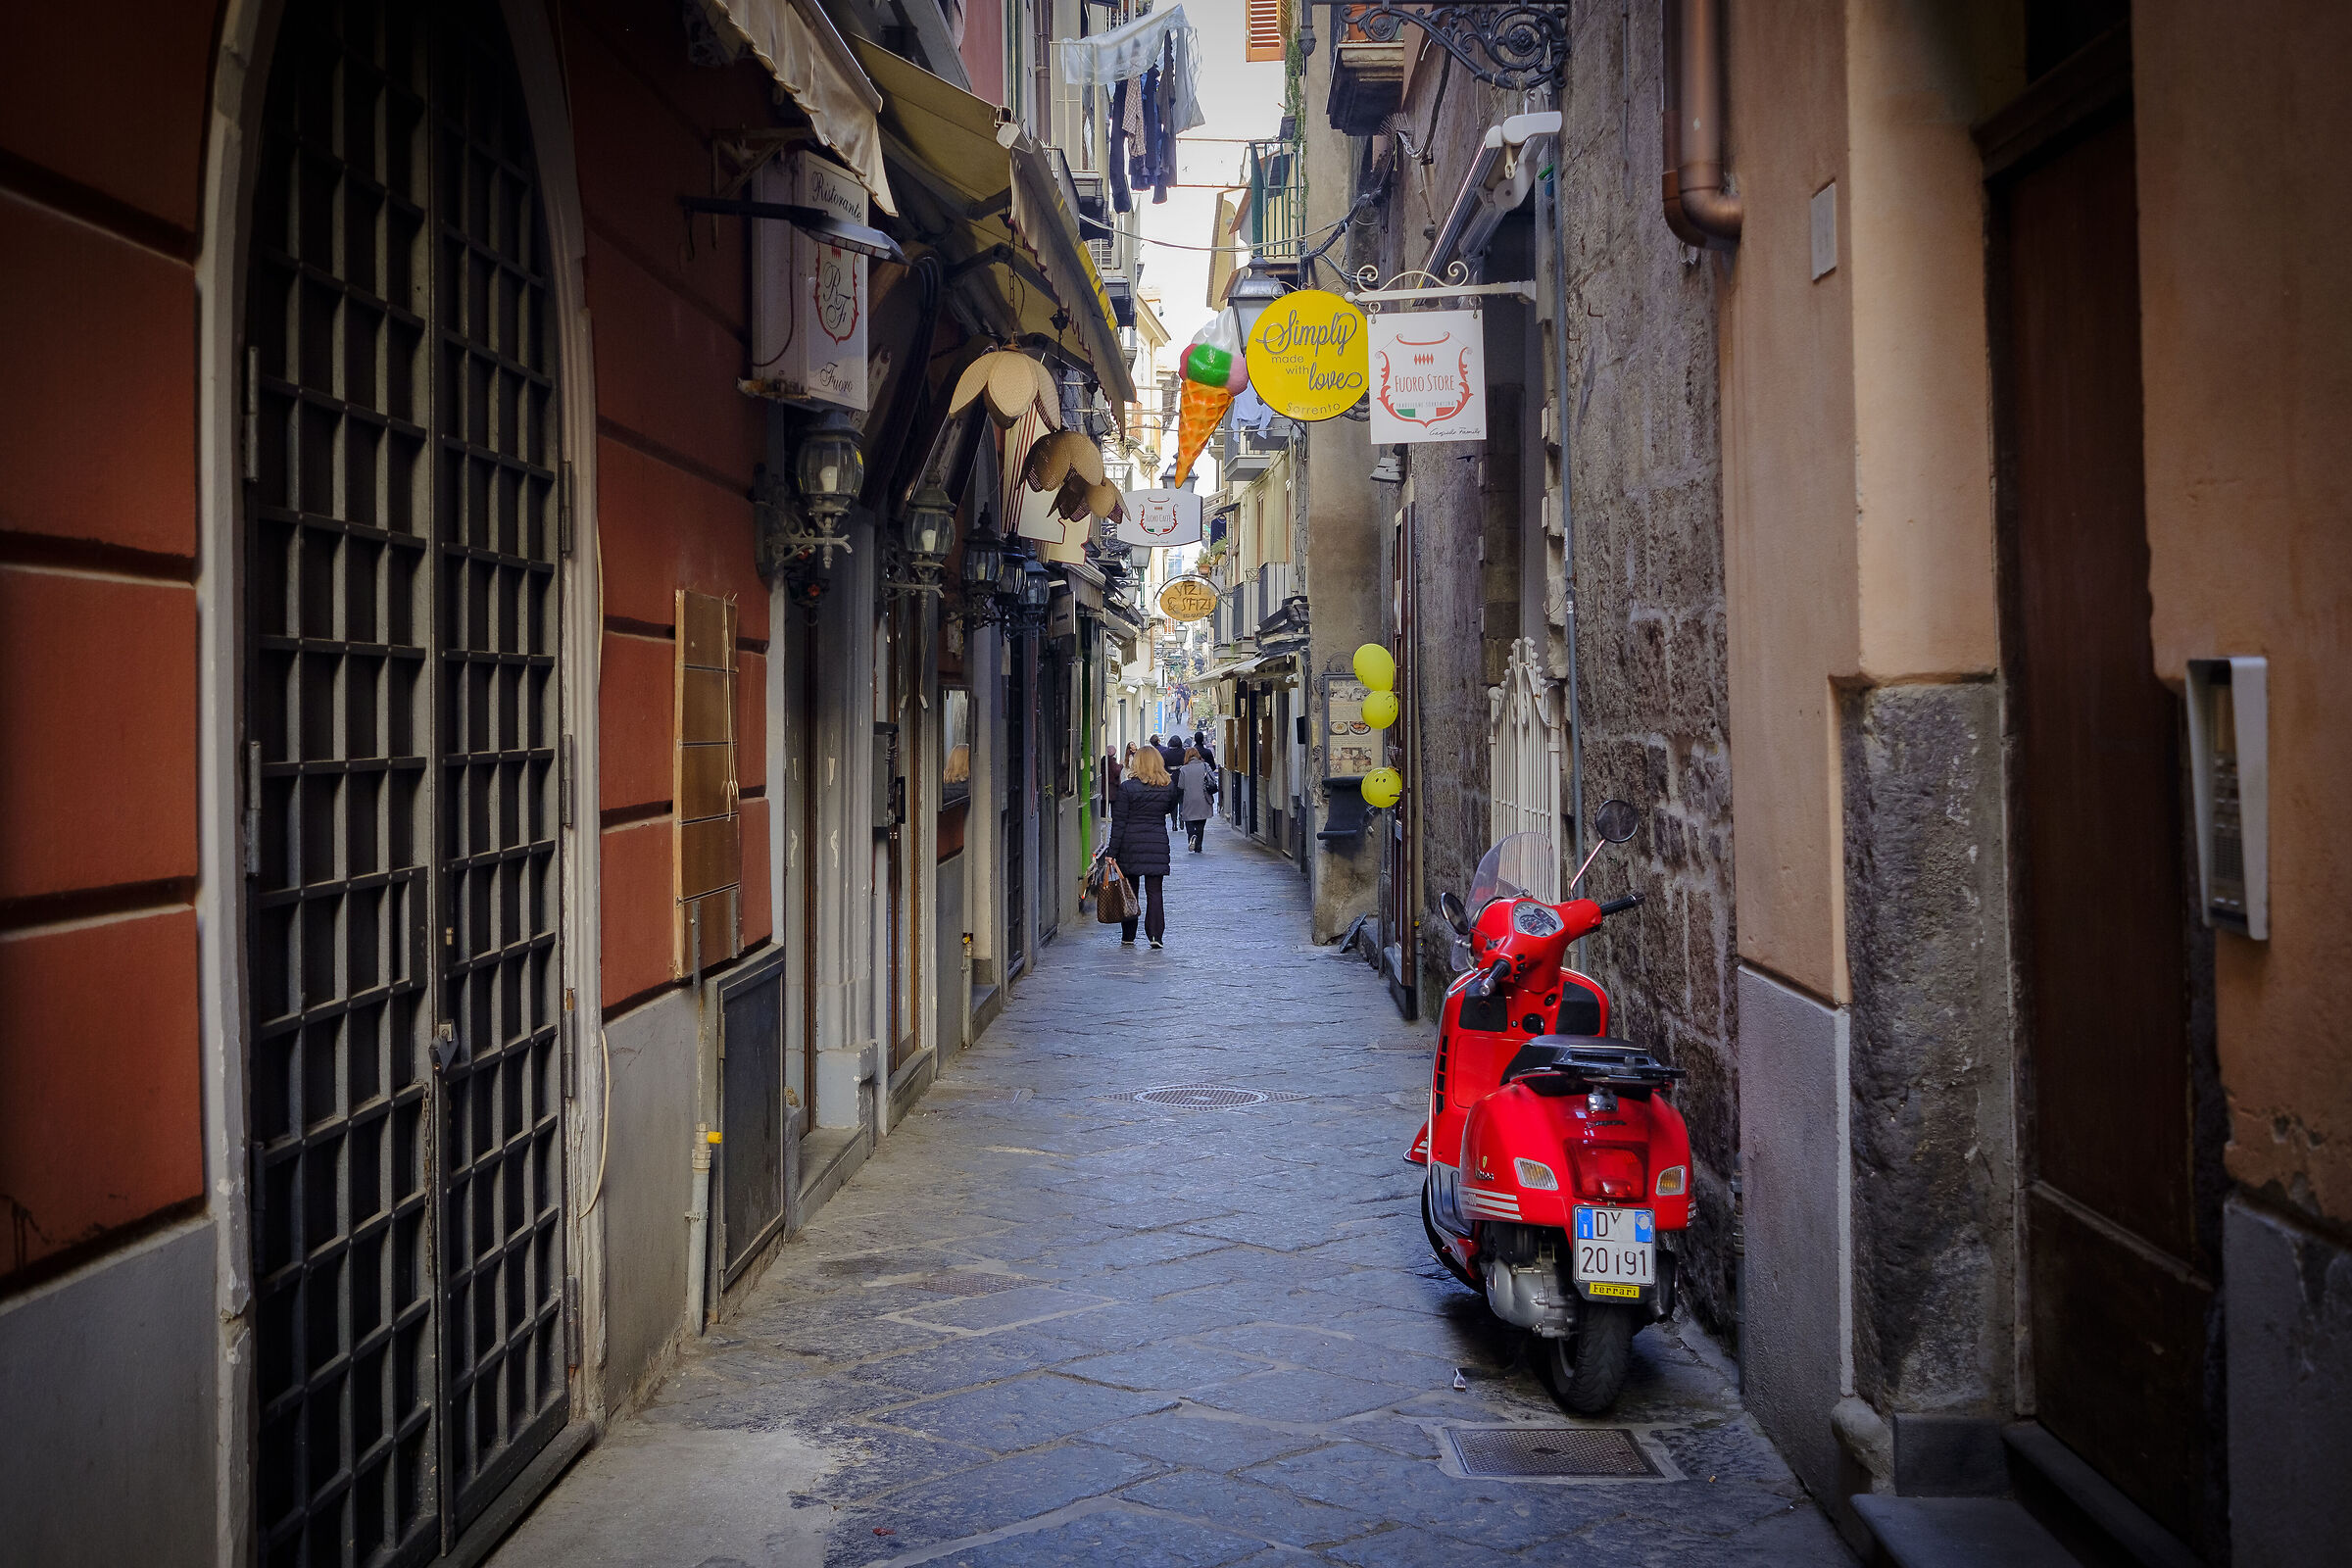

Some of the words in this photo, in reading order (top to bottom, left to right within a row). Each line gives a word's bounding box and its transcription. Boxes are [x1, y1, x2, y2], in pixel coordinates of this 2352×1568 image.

[810, 171, 862, 222] Ristorante
[1255, 310, 1357, 356] Simply
[1271, 354, 1304, 364] made
[820, 362, 853, 392] Fuoro
[1286, 366, 1309, 375] with
[1308, 362, 1363, 391] love
[1395, 375, 1425, 393] FUORO
[1427, 373, 1455, 392] STORE
[1286, 401, 1341, 416] Sorrento
[1175, 583, 1201, 596] VIZI
[1592, 1284, 1638, 1298] Ferrari
